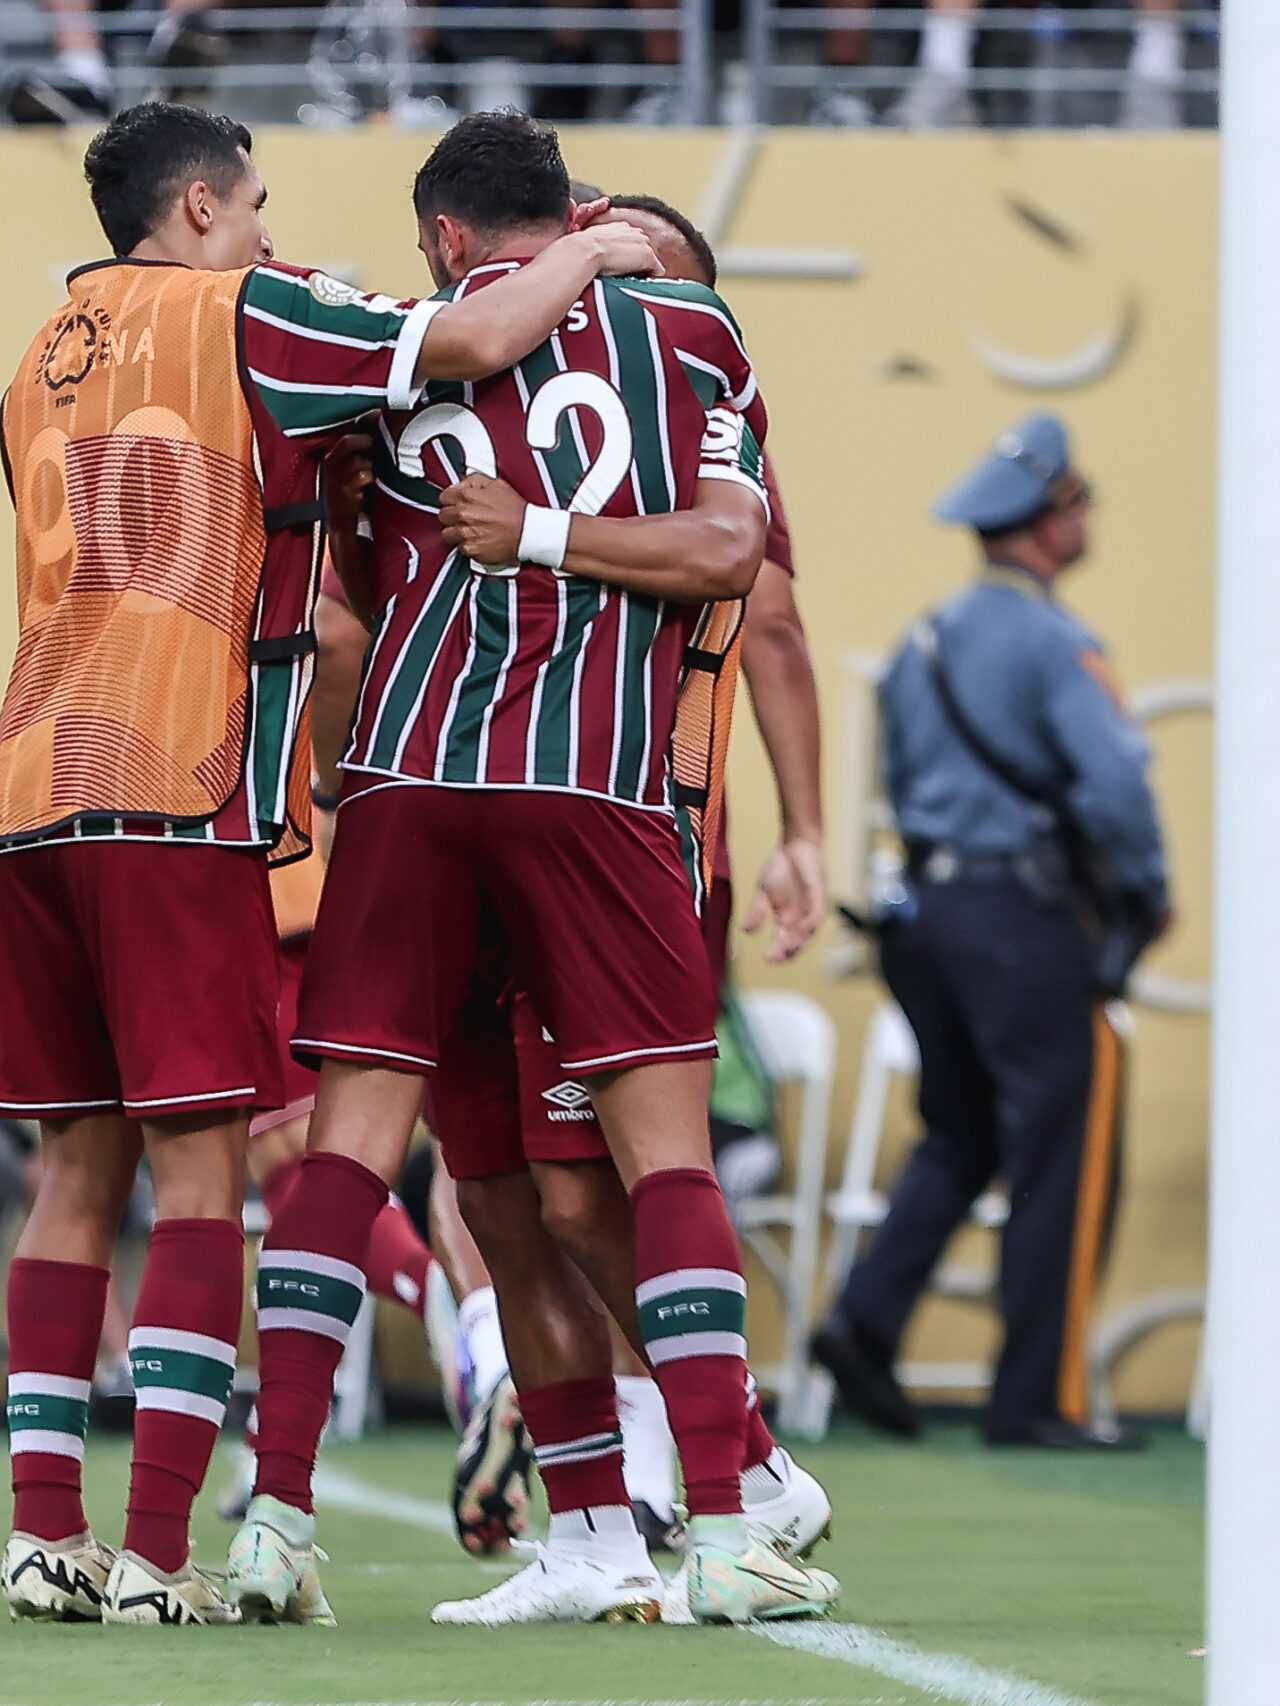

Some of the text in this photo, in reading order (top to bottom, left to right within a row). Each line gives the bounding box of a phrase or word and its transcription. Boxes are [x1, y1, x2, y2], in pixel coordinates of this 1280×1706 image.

[546, 1107, 595, 1123] umbro
[268, 1278, 320, 1297] FFC
[656, 1301, 711, 1321] FFC
[6, 1403, 41, 1417] FFC
